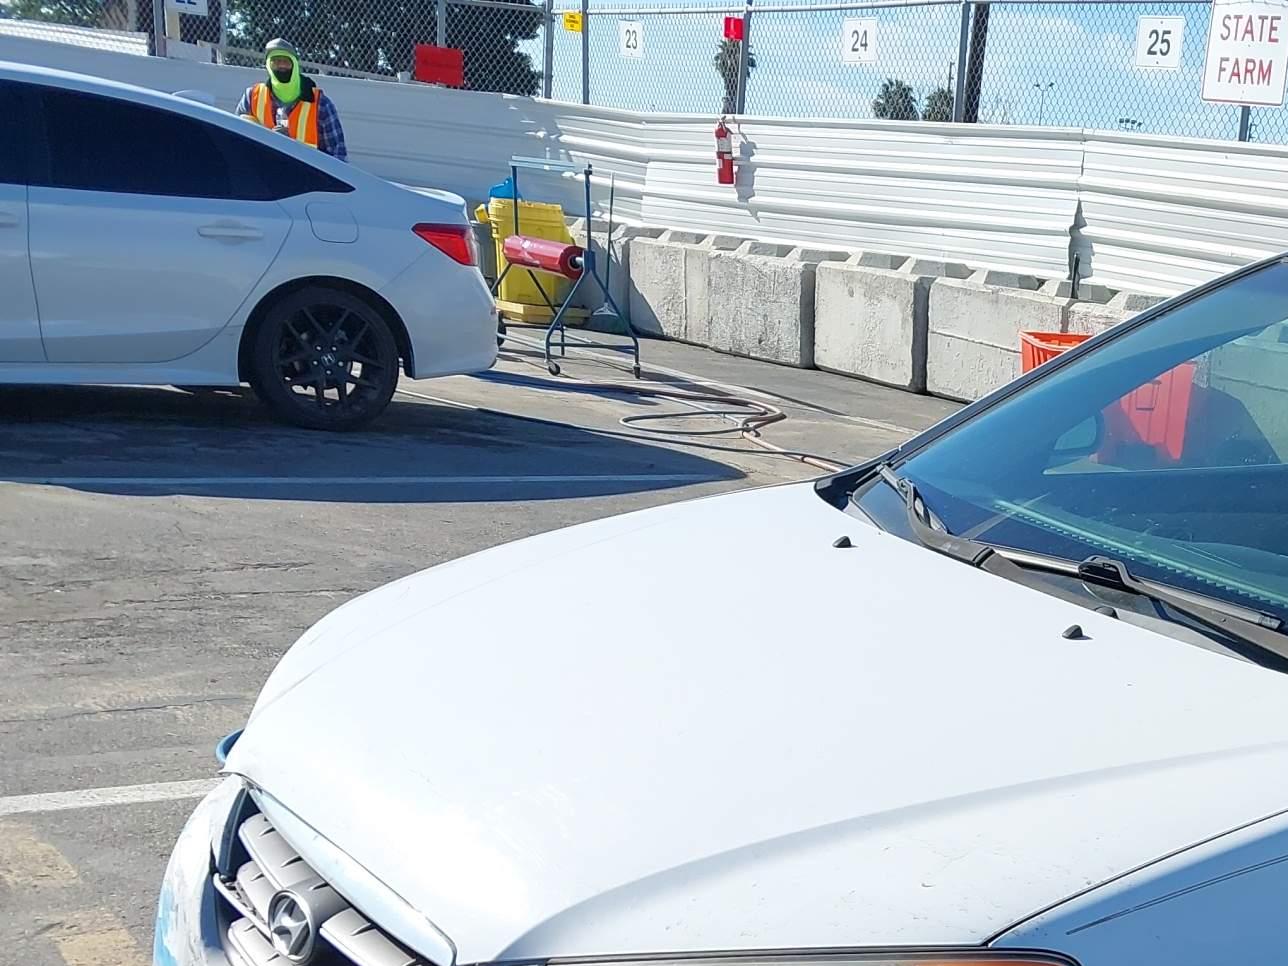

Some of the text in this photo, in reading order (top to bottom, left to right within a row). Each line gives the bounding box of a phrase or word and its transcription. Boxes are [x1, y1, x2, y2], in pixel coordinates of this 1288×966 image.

[625, 29, 638, 49] 23
[851, 29, 868, 52] 24
[1220, 14, 1281, 43] STATE
[1147, 29, 1172, 56] 25
[1217, 57, 1273, 86] FARM
